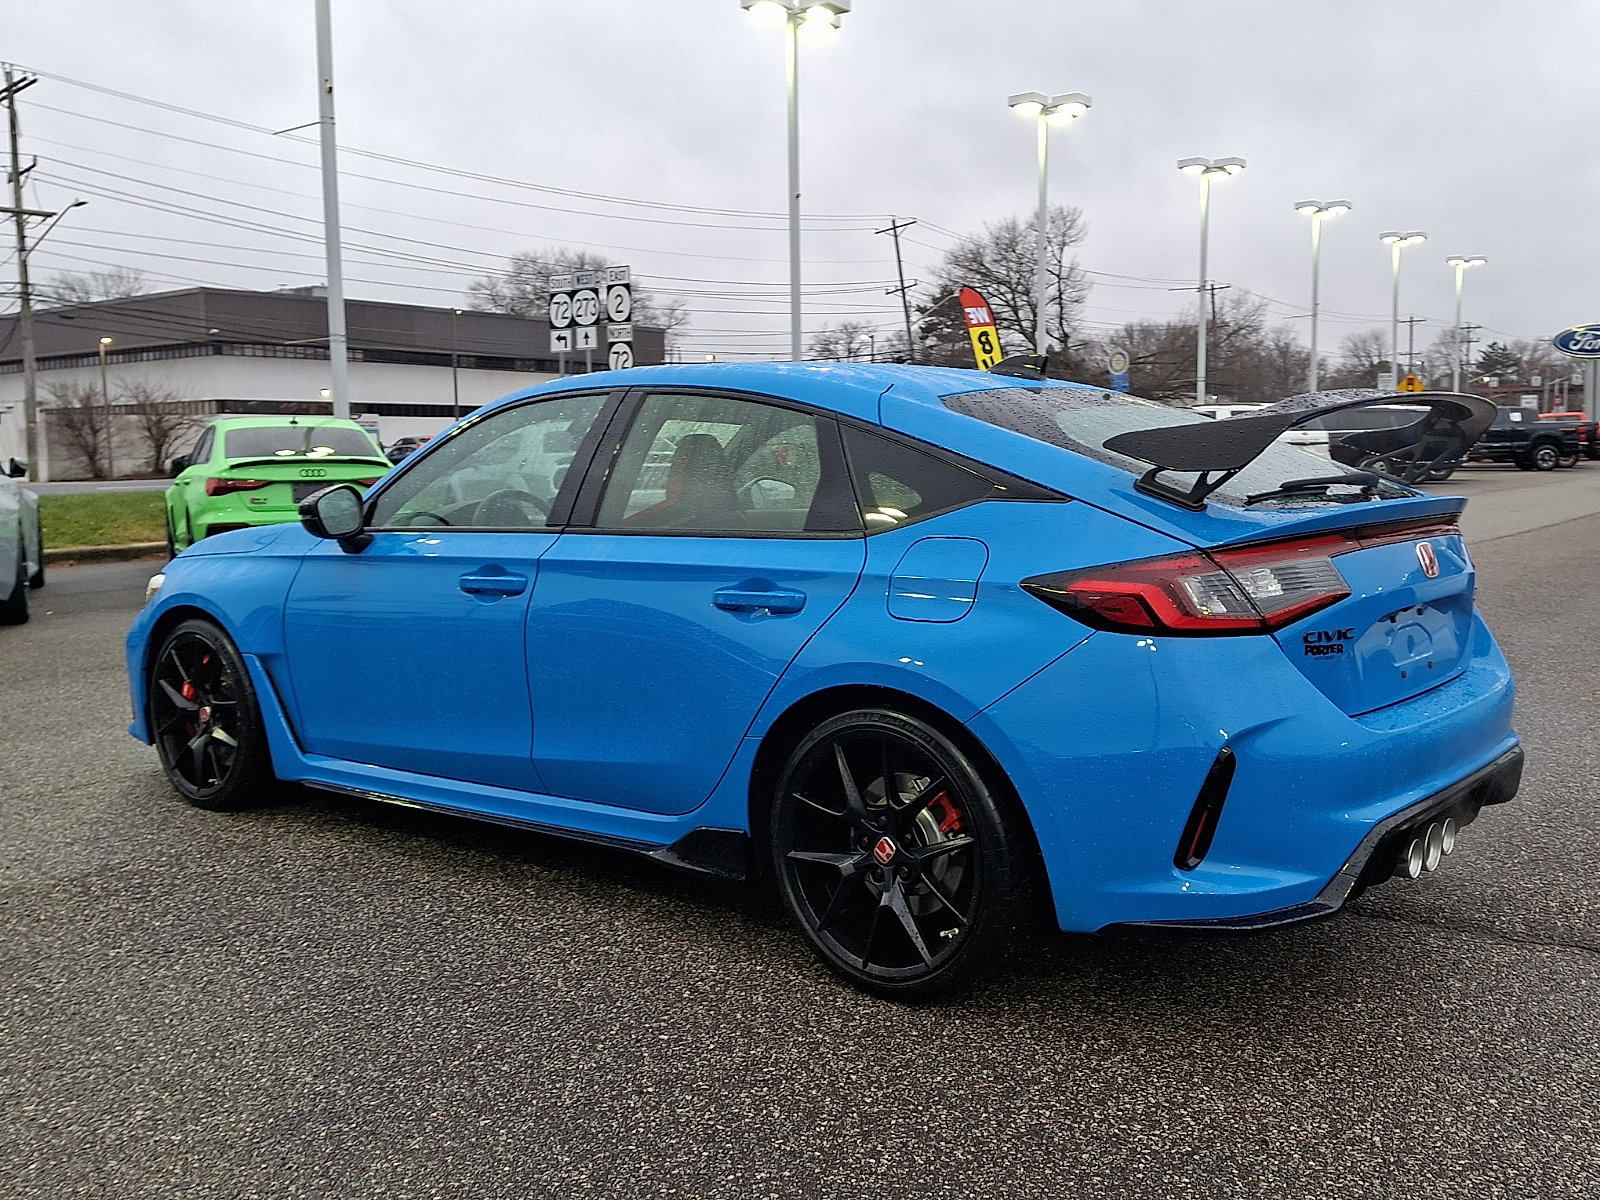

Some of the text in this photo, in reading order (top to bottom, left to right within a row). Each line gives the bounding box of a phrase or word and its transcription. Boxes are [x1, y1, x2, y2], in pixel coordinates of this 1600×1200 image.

[576, 274, 592, 284] WEST
[610, 270, 626, 281] EAST
[550, 279, 571, 289] SOUTH
[552, 301, 569, 320] 72
[575, 297, 597, 318] 273
[614, 293, 624, 314] 2
[609, 328, 632, 339] NORTH
[612, 351, 629, 369] 72
[1303, 627, 1355, 644] CIVIC
[1304, 643, 1344, 656] PORTER
